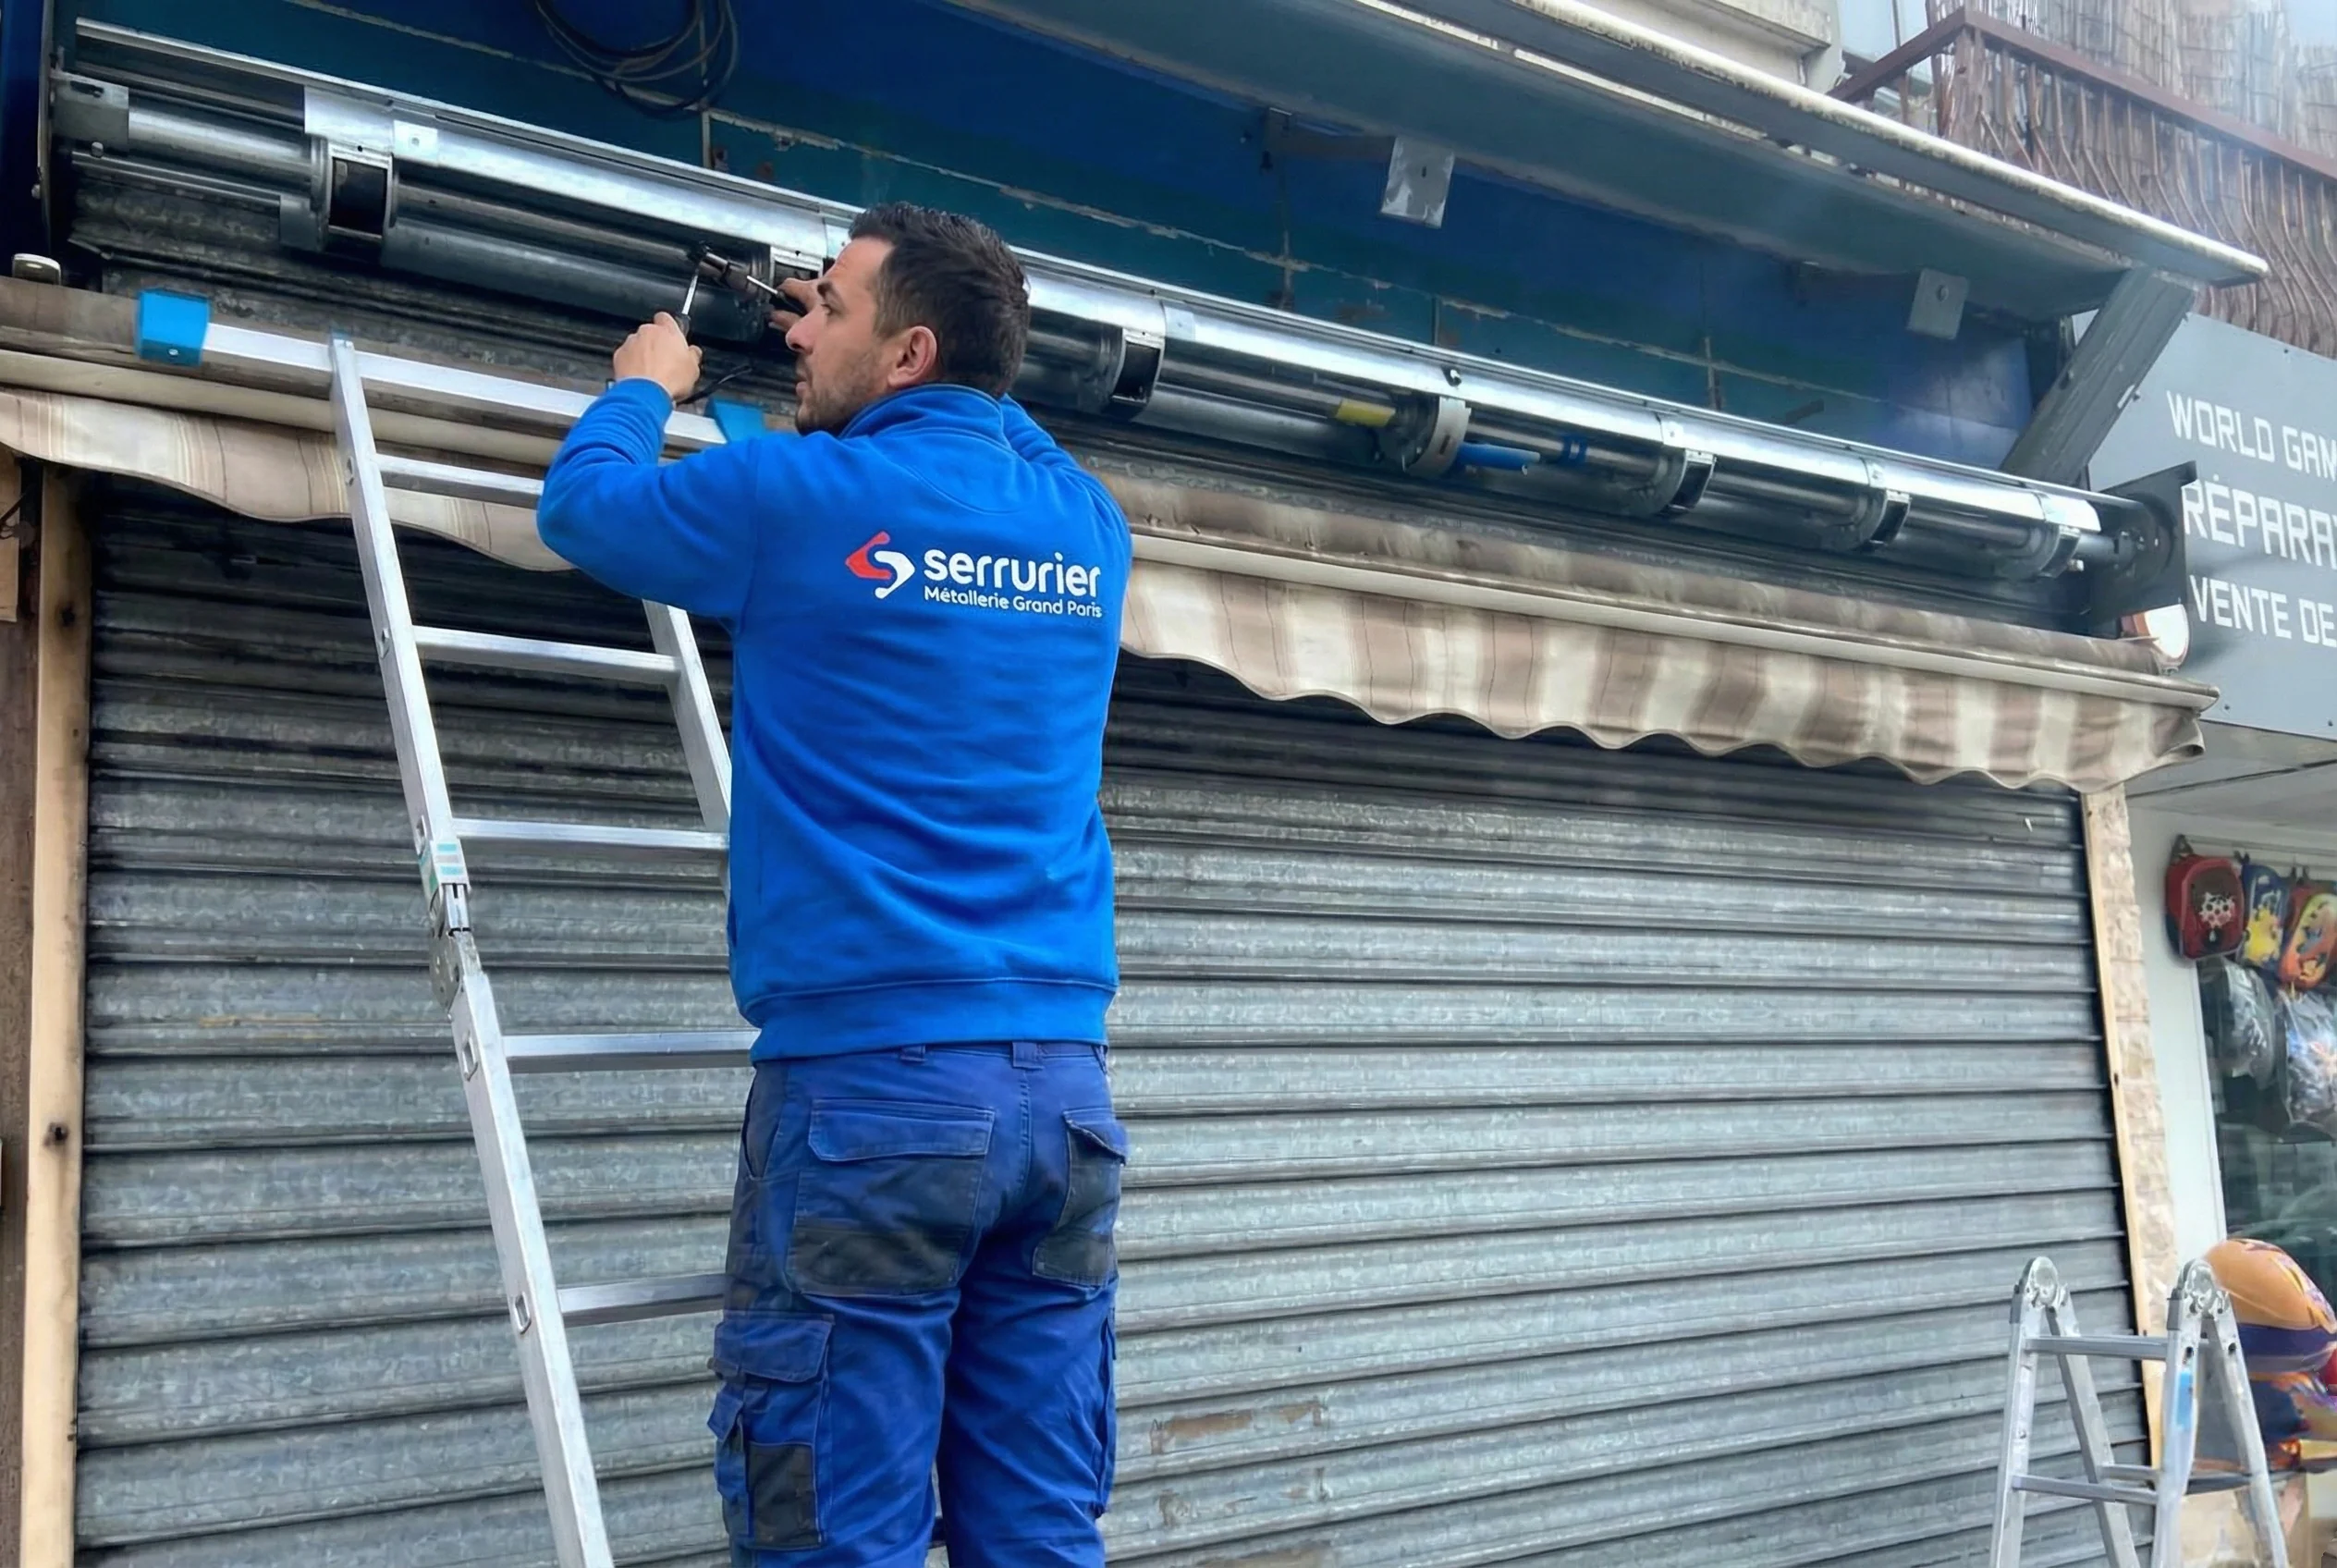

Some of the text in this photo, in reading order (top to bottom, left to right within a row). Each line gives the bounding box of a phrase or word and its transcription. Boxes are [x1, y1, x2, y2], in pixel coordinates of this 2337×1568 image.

[2166, 390, 2276, 462] WORLD
[2181, 473, 2337, 571] RÉPARA
[924, 585, 1103, 619] Métallerie Grand Paris
[2189, 574, 2337, 648] VENTE DE
